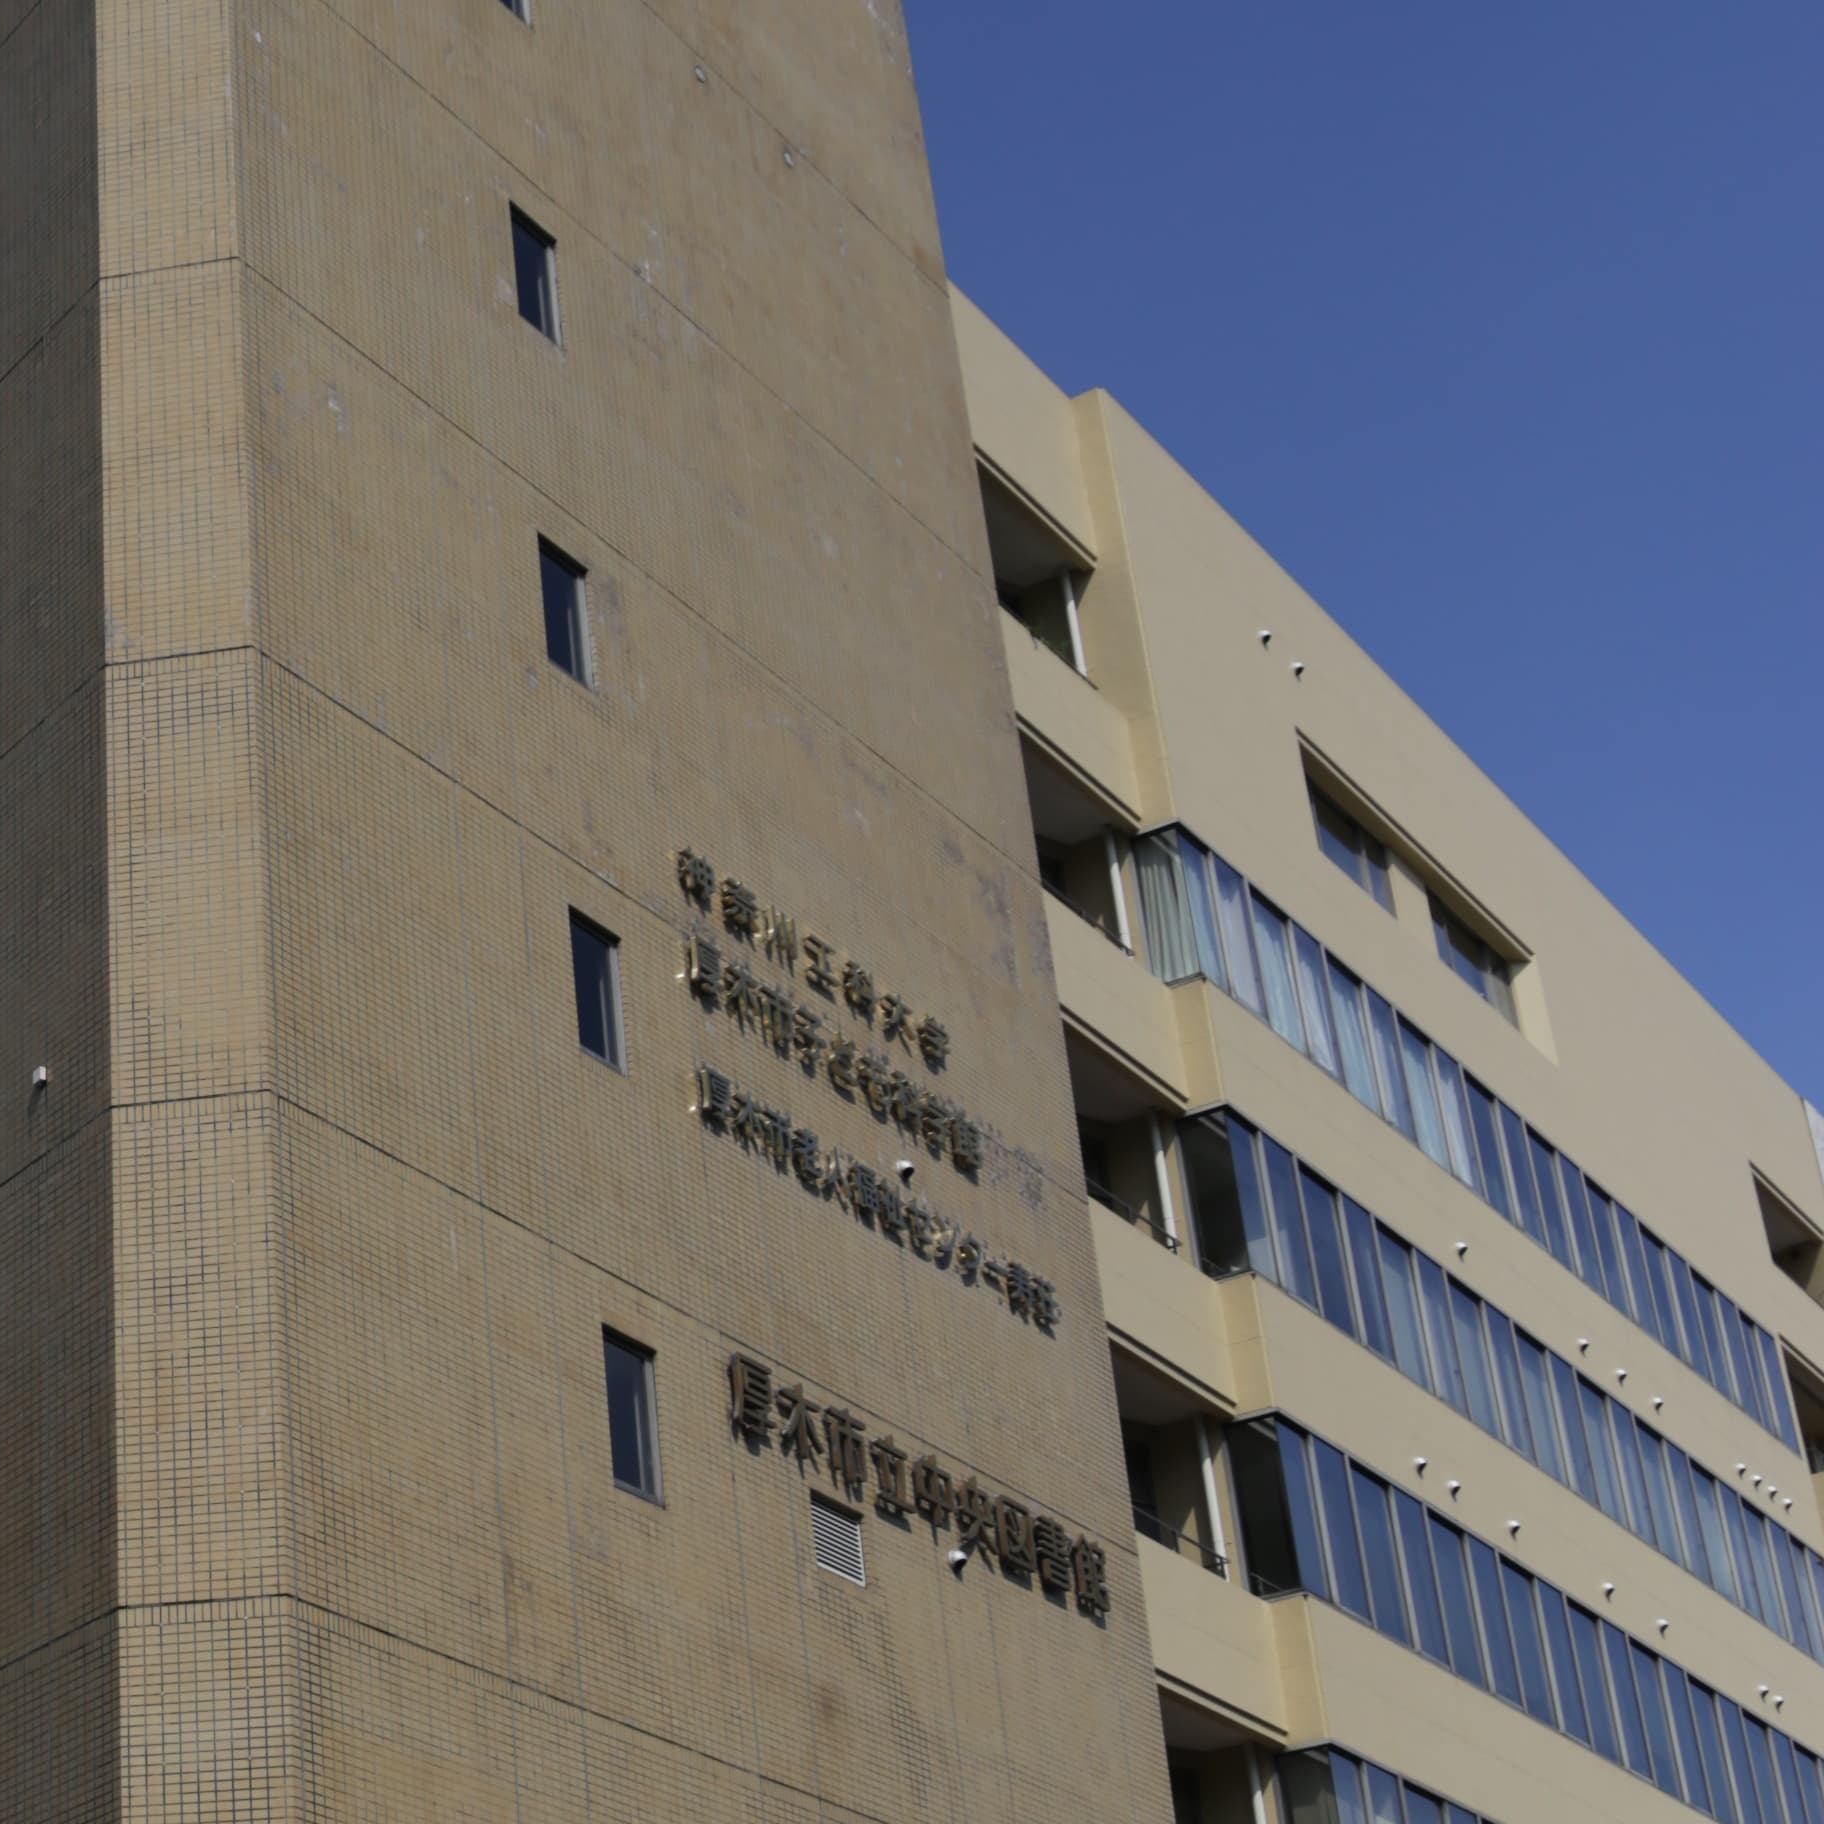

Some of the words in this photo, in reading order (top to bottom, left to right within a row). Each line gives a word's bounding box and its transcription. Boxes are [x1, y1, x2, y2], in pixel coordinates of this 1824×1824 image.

[727, 1351, 1110, 1616] 厚木市立中央図書館
